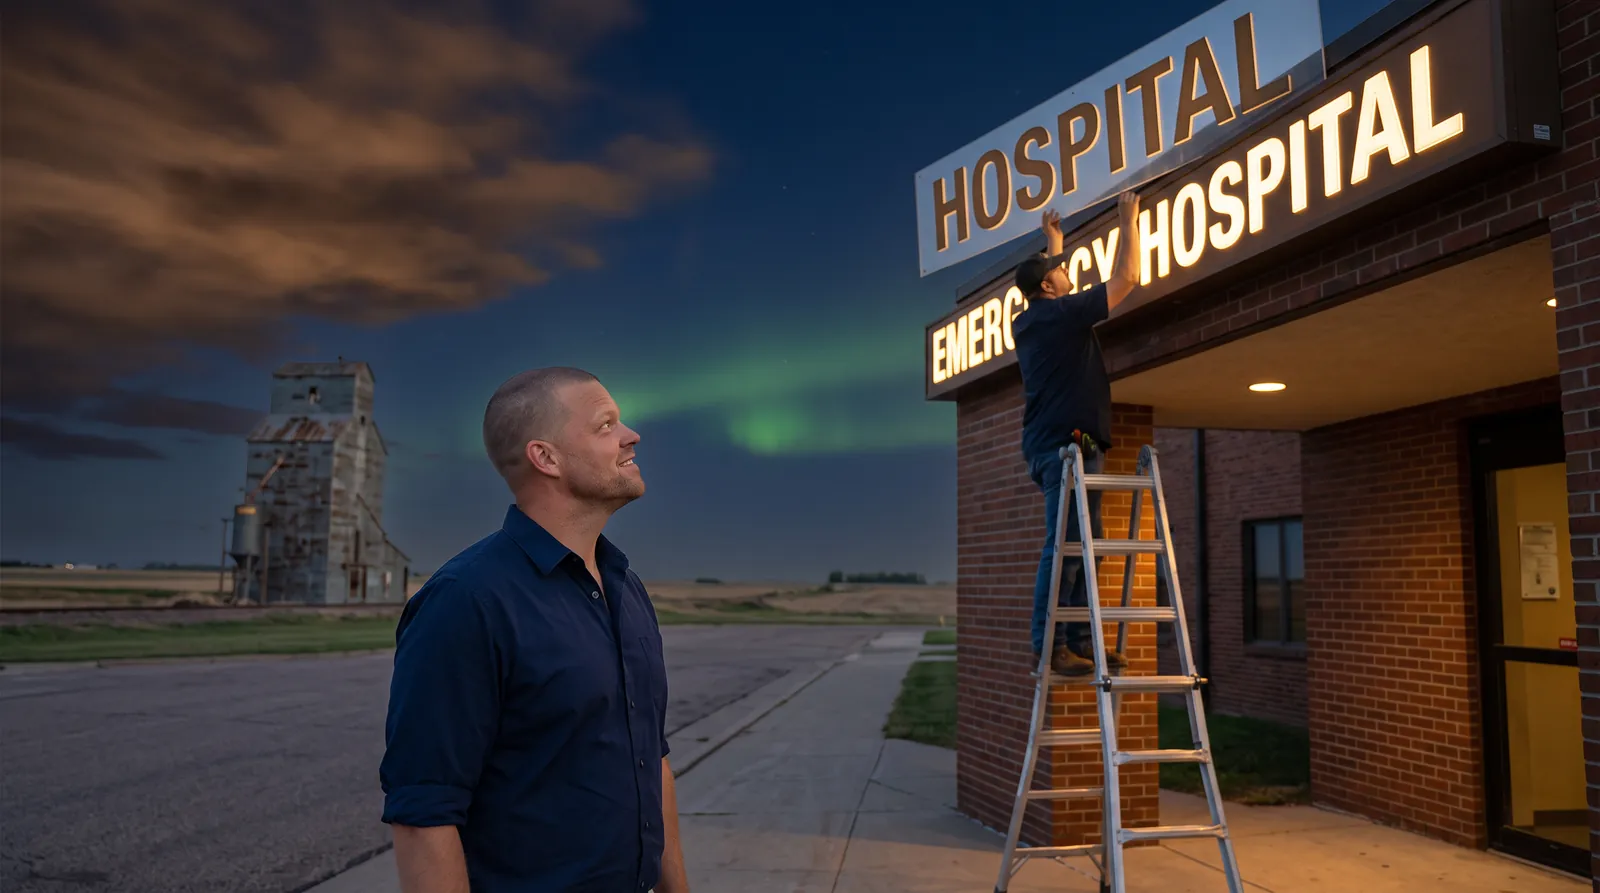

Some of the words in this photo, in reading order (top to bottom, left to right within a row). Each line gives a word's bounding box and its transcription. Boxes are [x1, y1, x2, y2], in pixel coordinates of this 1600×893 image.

[932, 227, 1120, 384] EMERGCY
[1138, 45, 1464, 286] HOSPITAL
[934, 13, 1292, 252] HOSPITAL
